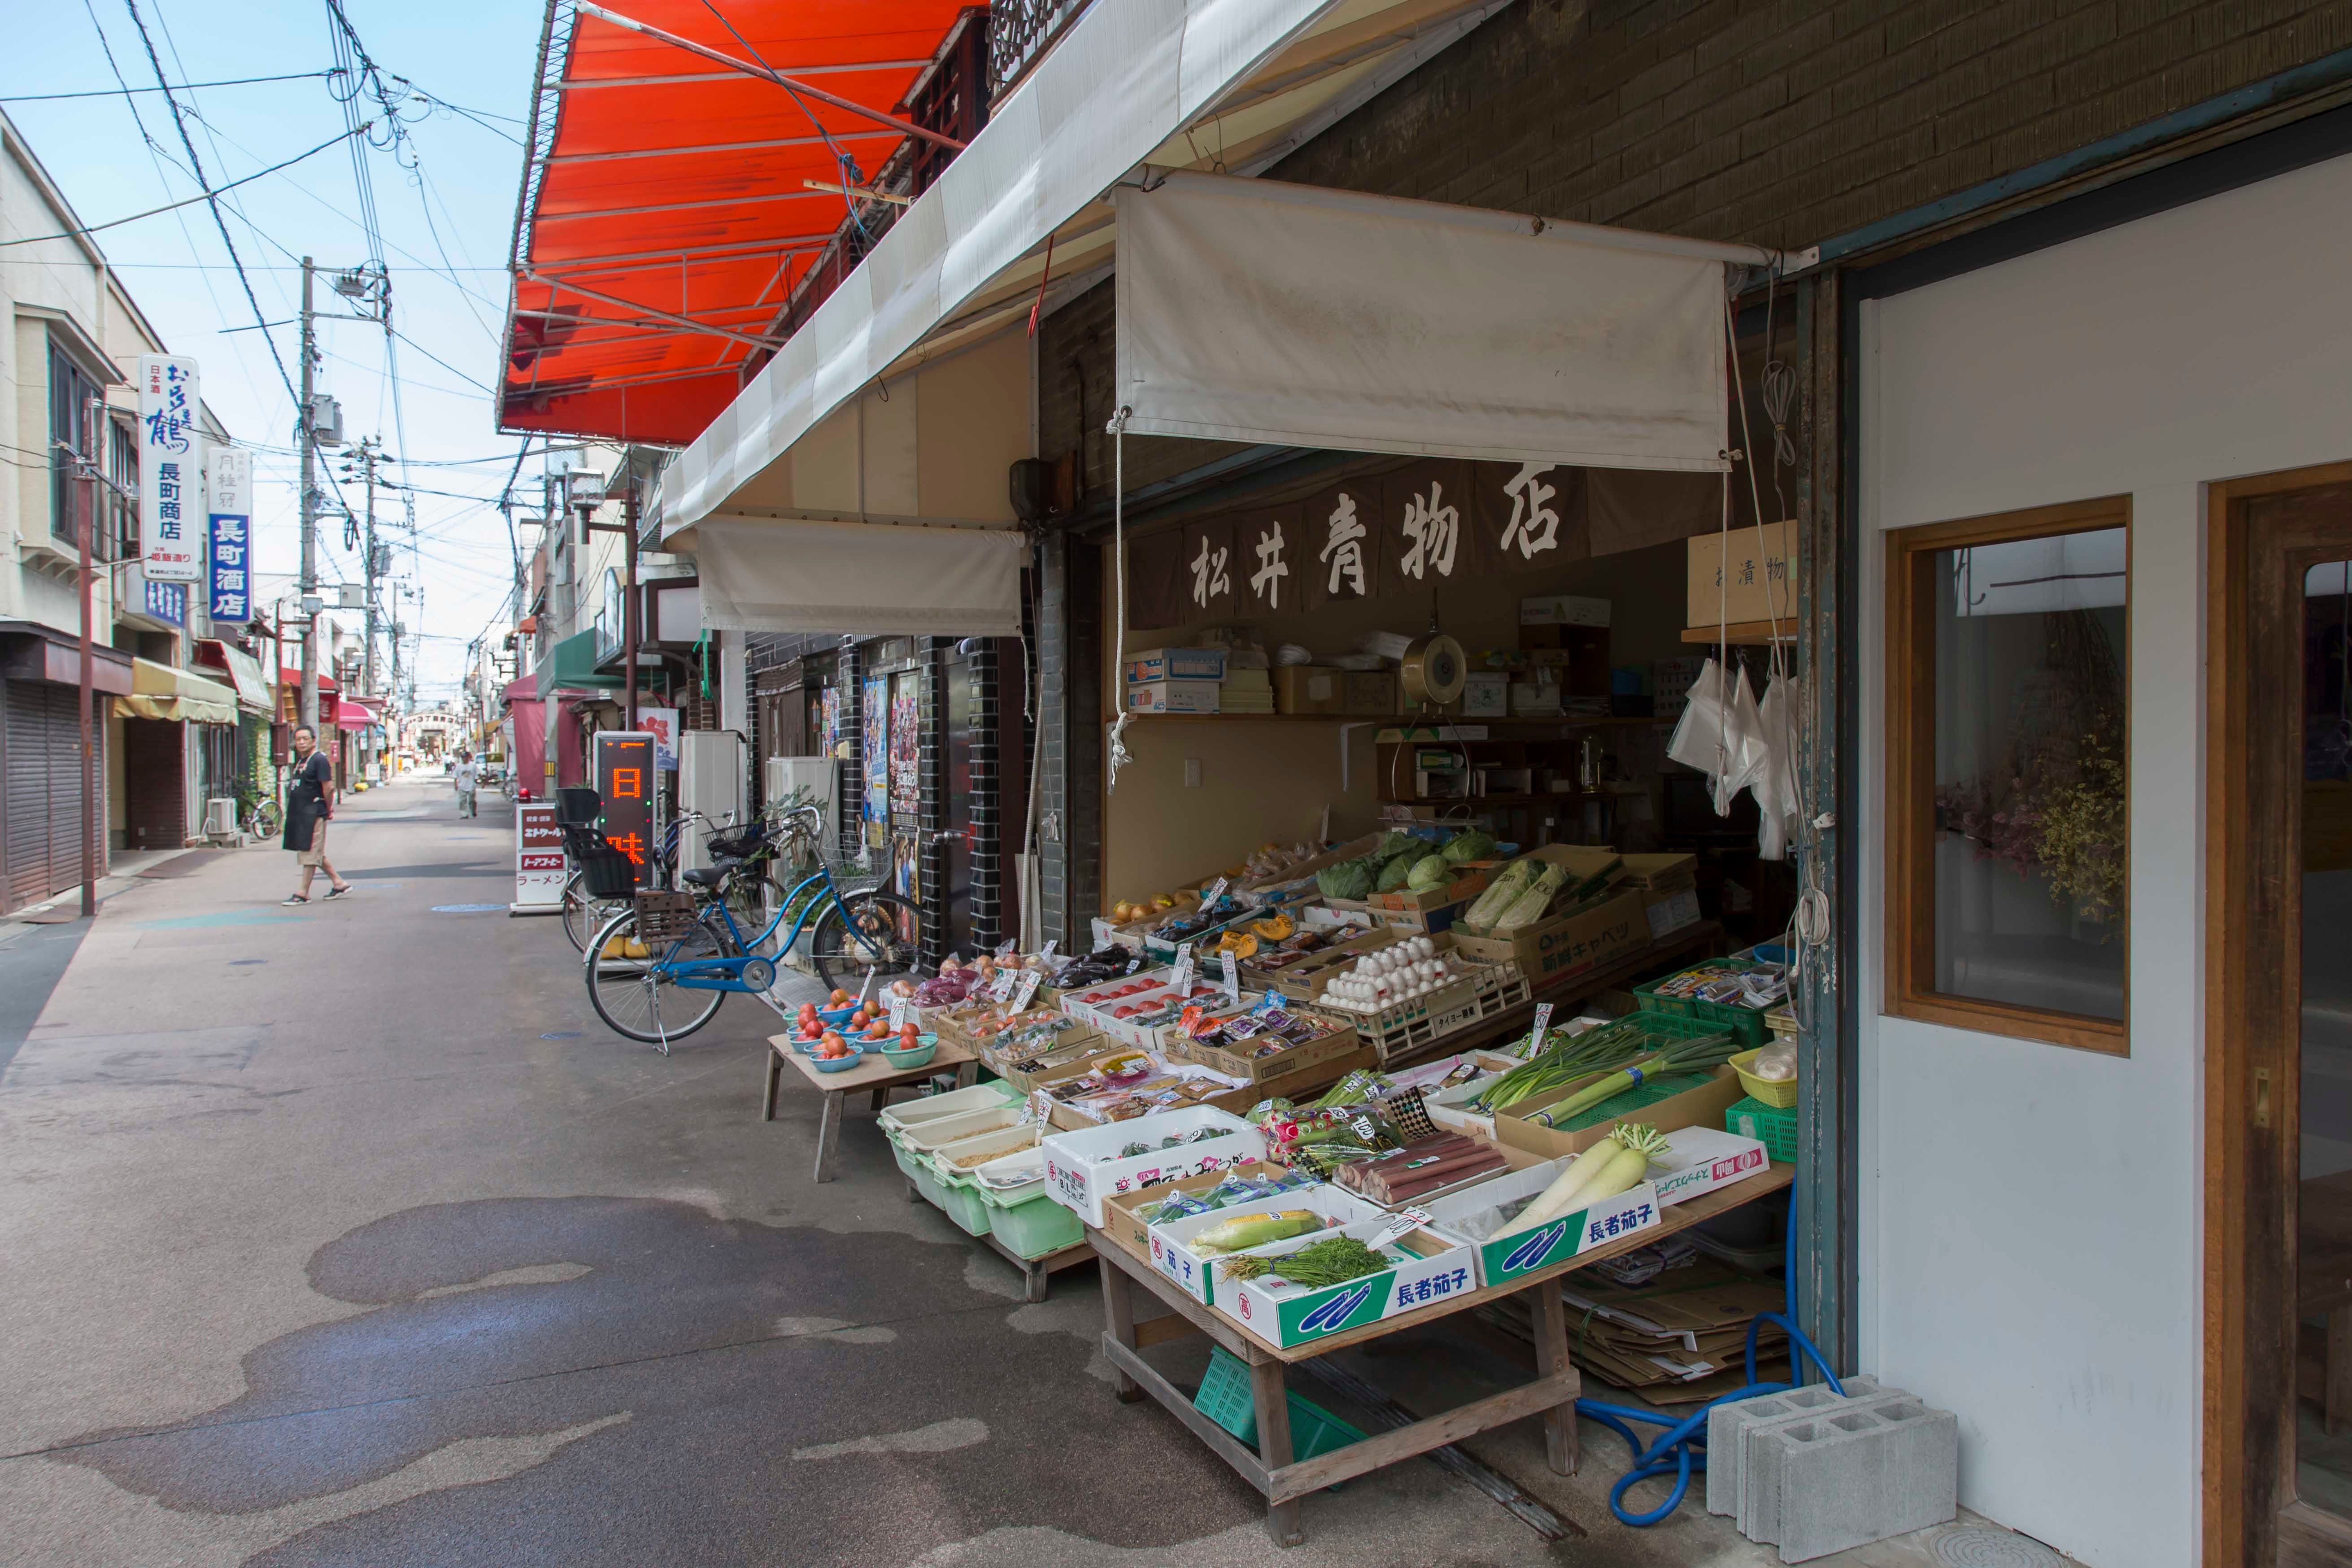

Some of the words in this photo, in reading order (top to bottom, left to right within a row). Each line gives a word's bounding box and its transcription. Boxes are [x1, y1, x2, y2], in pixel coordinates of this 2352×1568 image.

[150, 365, 160, 393] 日本酒
[218, 455, 236, 507] 月桂冠
[159, 462, 181, 540] 長町商店
[1191, 463, 1559, 609] 松井青物店
[213, 519, 247, 617] 長町酒店
[524, 828, 561, 837] エトワール
[518, 875, 565, 885] ラーメン
[1542, 922, 1629, 972] 新鮮キャベツ
[1060, 1178, 1064, 1189] B
[1716, 1159, 1734, 1178] 岡山
[1066, 1183, 1071, 1193] L
[1386, 1217, 1417, 1234] 100
[1589, 1203, 1653, 1244] 長者茄子
[1167, 1249, 1192, 1279] 茄子
[1397, 1267, 1468, 1307] 長者茄子
